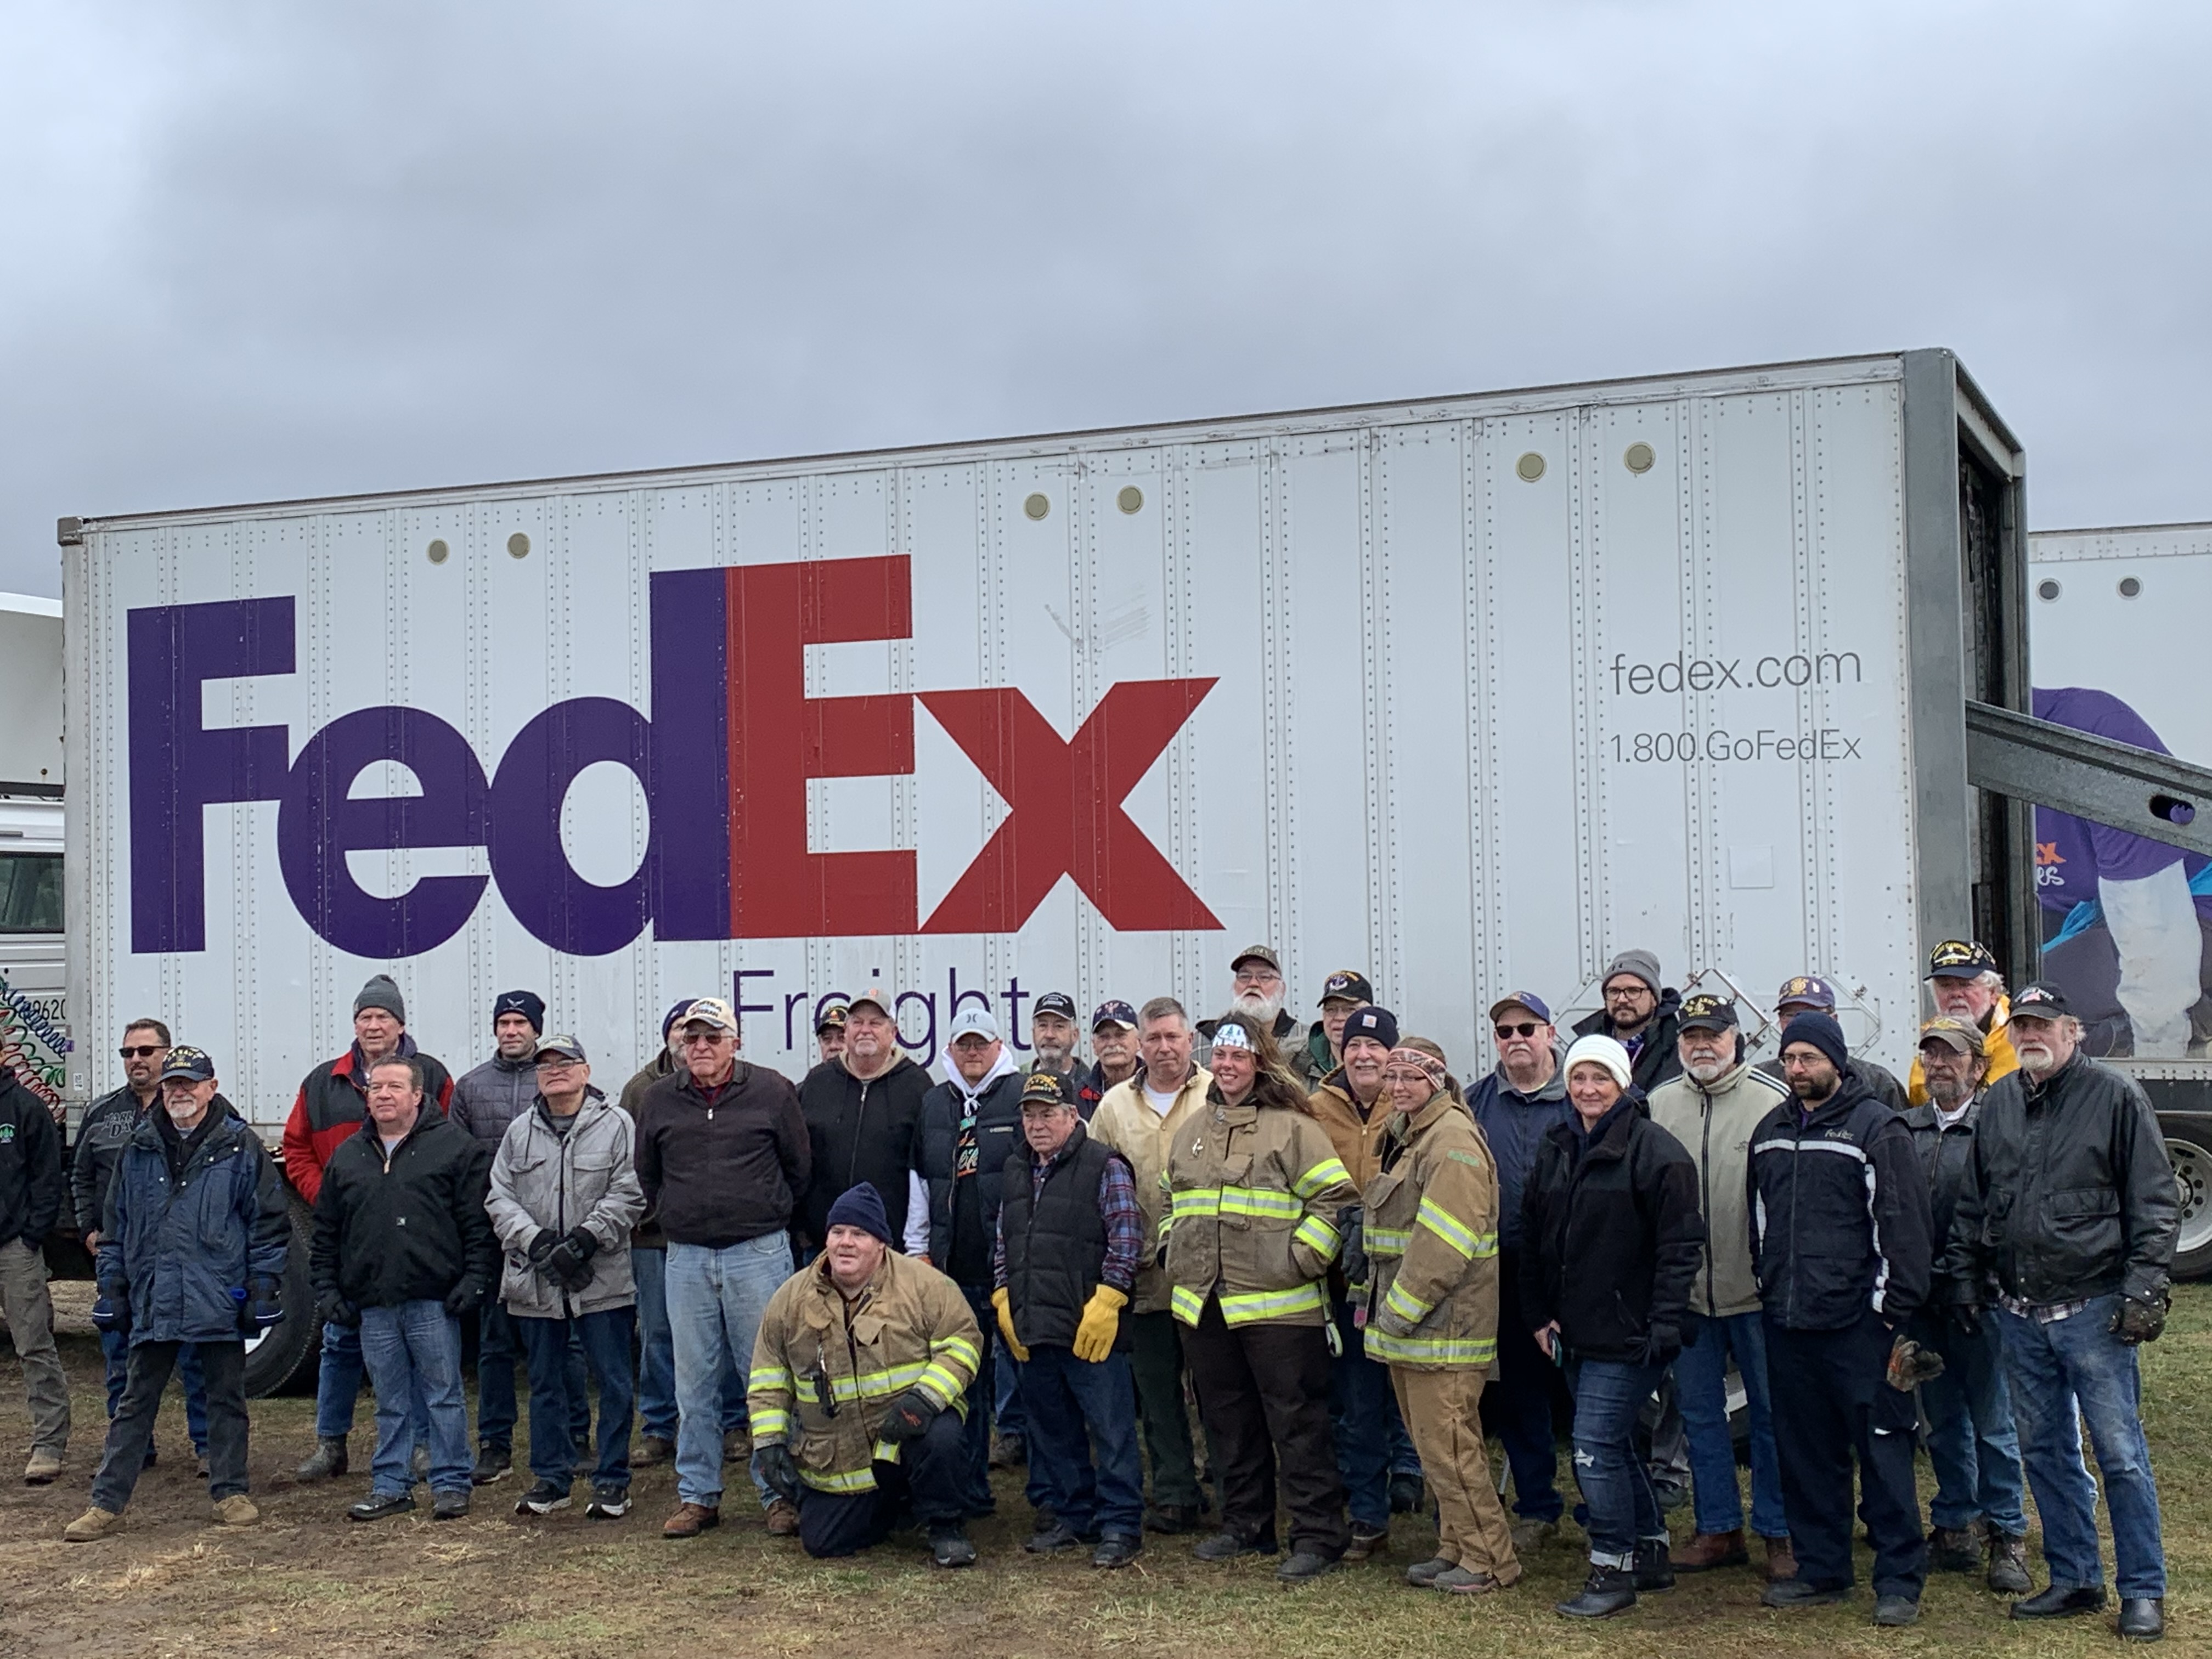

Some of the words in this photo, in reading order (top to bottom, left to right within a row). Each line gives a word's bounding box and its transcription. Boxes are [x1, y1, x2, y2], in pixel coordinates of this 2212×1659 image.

[1610, 651, 1862, 696] fedex.com
[127, 555, 1227, 958] FedEx
[1610, 729, 1862, 764] 1.800.GoFedEx
[734, 968, 1032, 1069] Frght
